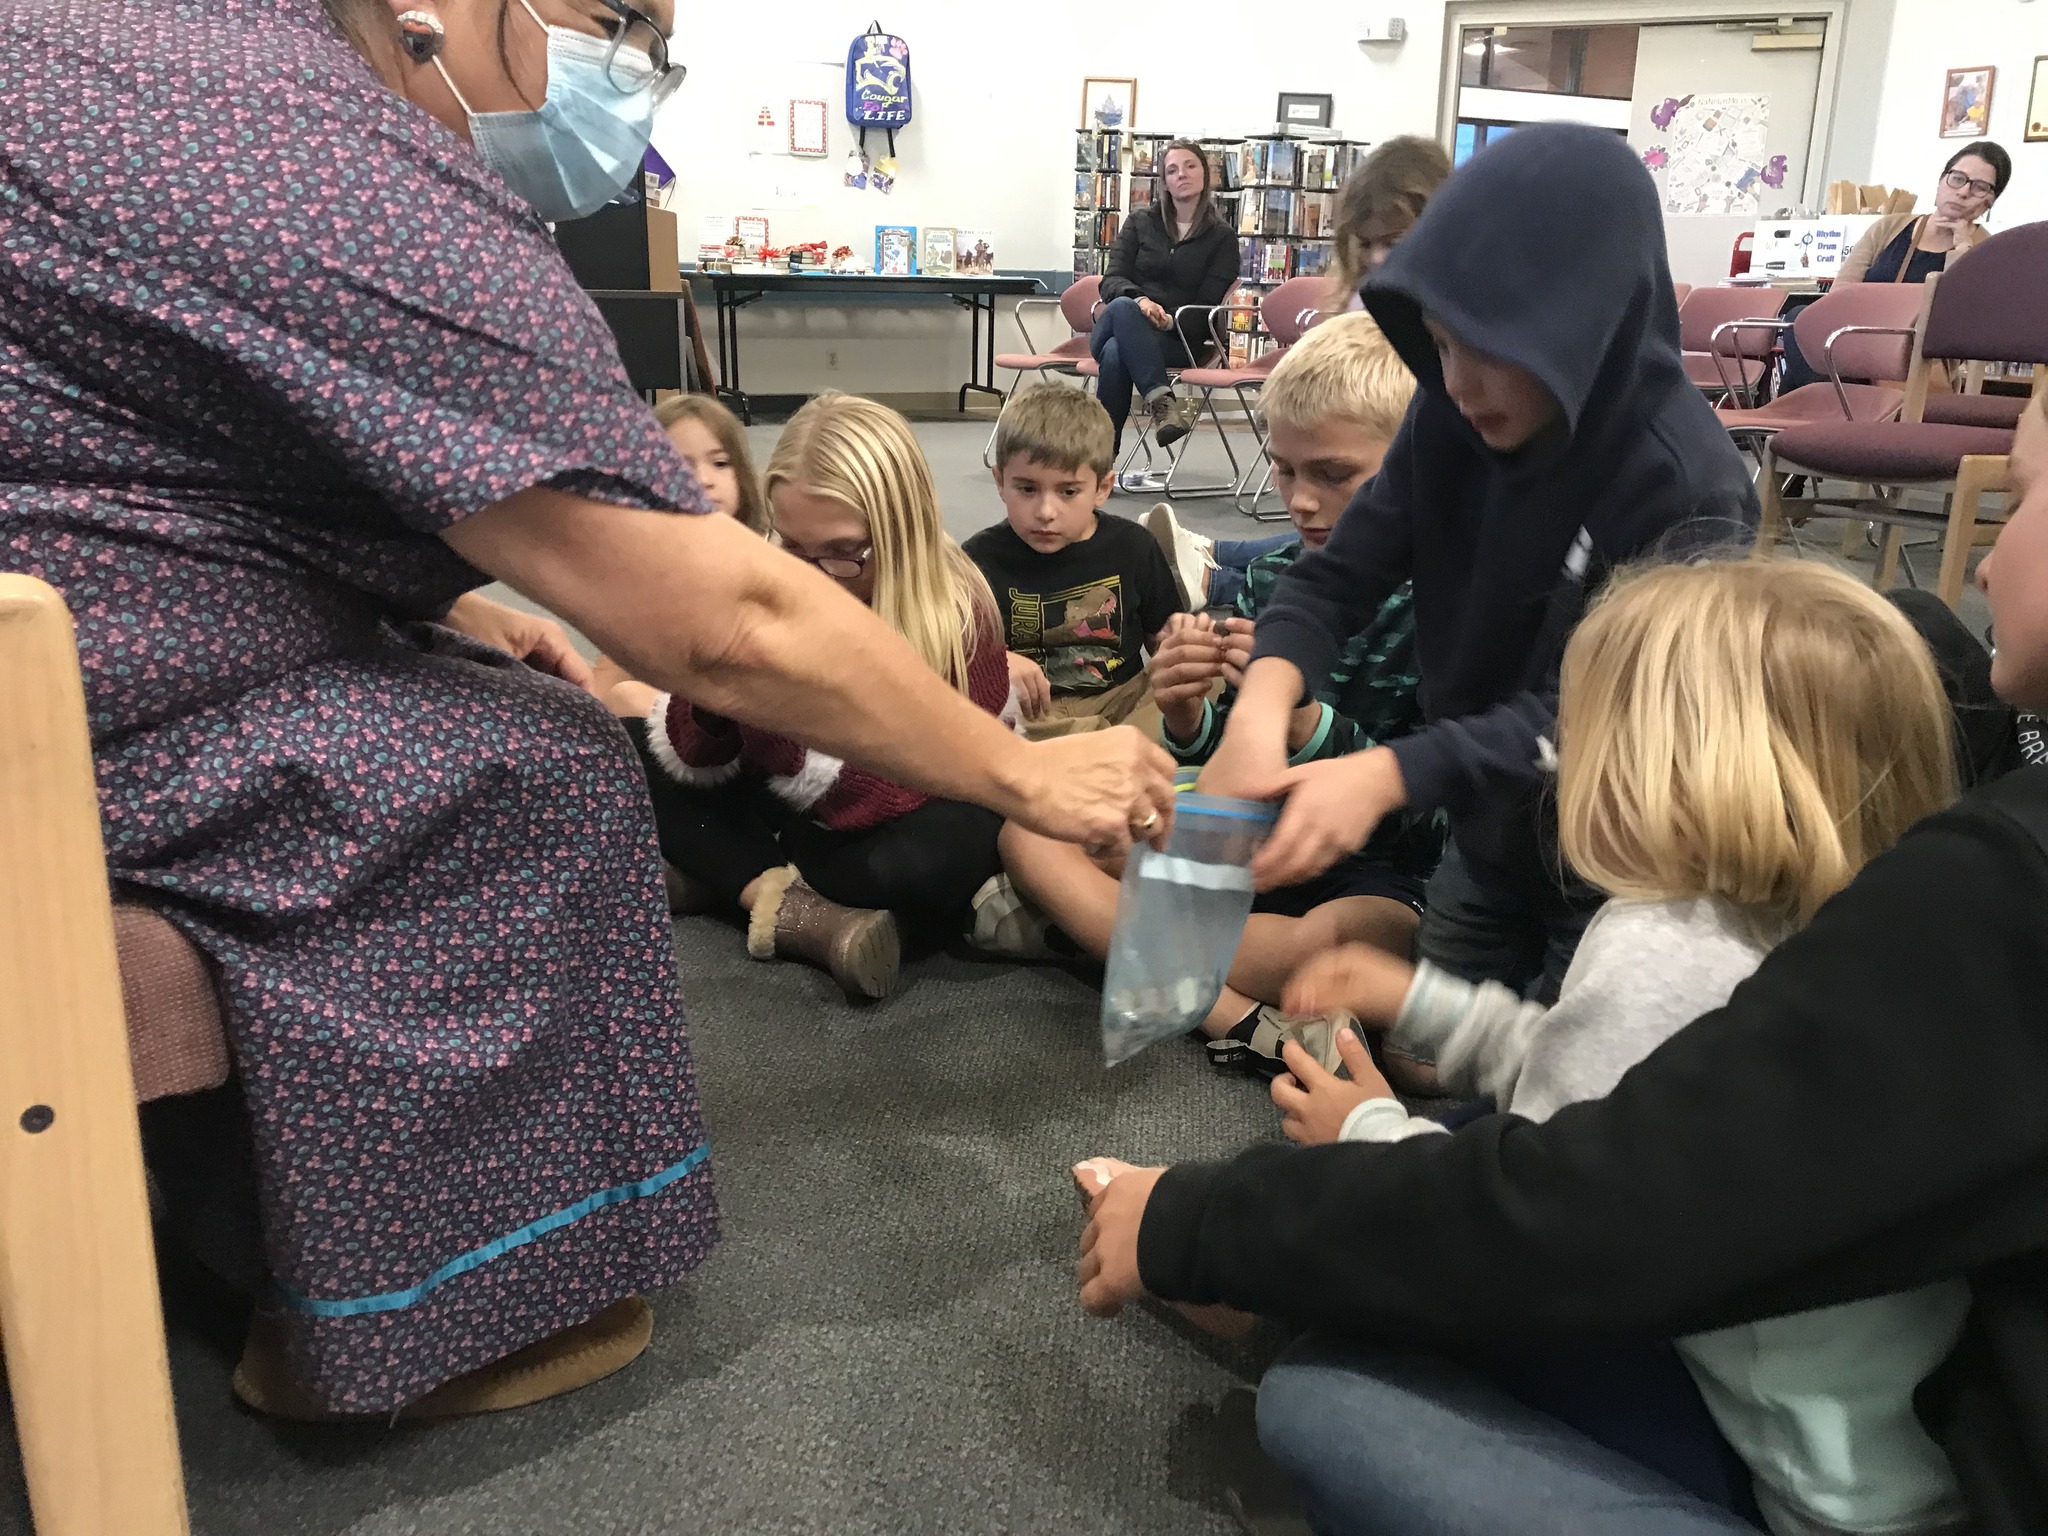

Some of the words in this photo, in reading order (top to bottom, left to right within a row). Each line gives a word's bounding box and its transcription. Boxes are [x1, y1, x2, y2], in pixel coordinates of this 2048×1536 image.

[861, 89, 907, 108] Cougar
[863, 110, 905, 120] LIFE
[1816, 230, 1841, 239] Rhythm
[1817, 242, 1837, 250] Drum
[1816, 255, 1835, 263] Craft
[1008, 587, 1041, 645] JURA
